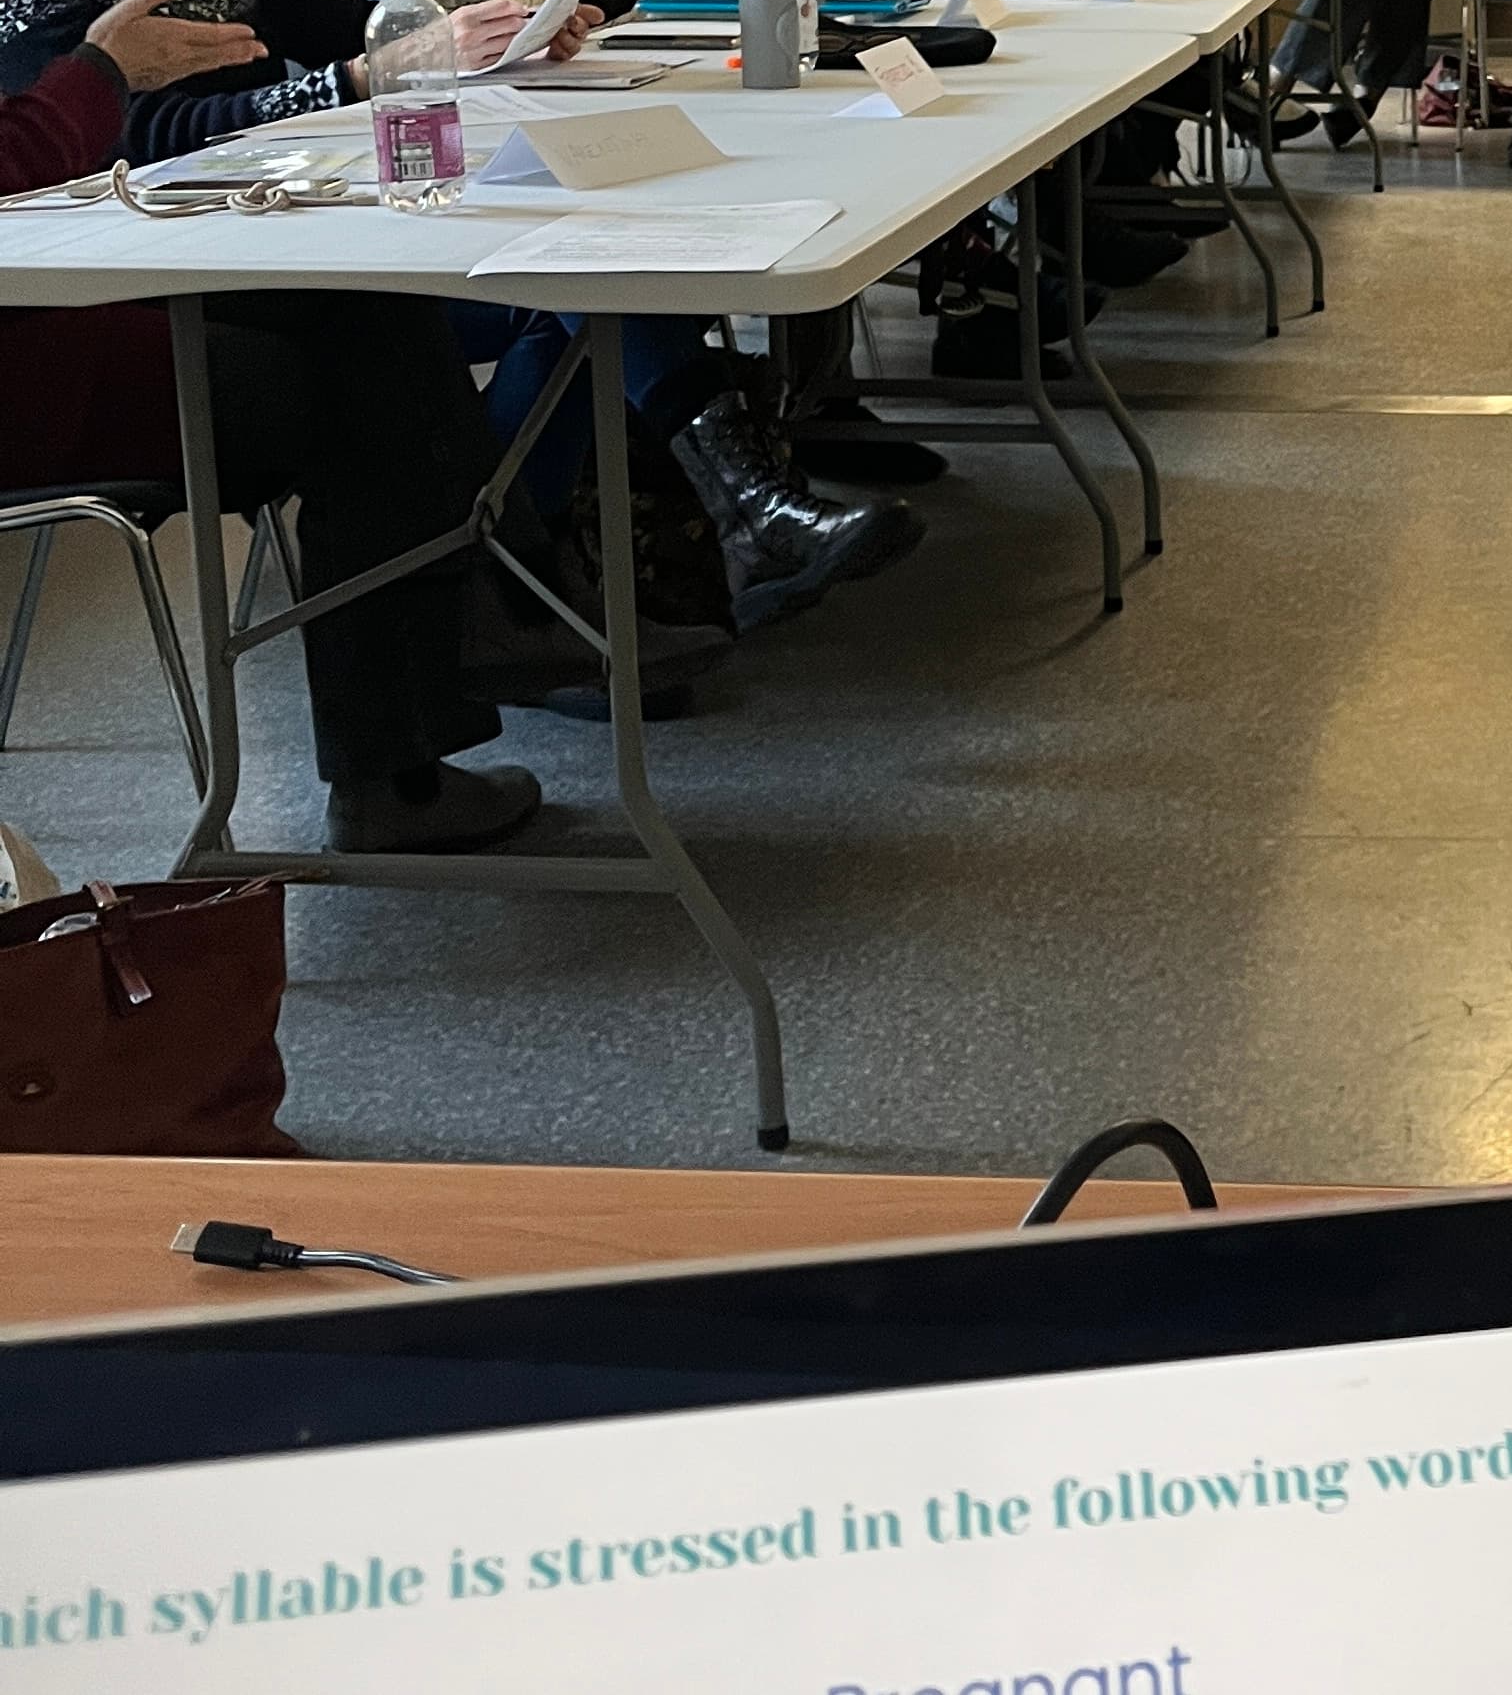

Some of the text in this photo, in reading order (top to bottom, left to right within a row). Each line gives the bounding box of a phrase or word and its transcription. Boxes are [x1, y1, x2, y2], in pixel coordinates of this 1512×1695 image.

[150, 1556, 426, 1644] syllable
[448, 1548, 504, 1600] is
[527, 1507, 819, 1591] stressed
[841, 1502, 903, 1554] in
[923, 1489, 1031, 1545] the
[1052, 1457, 1351, 1530] following
